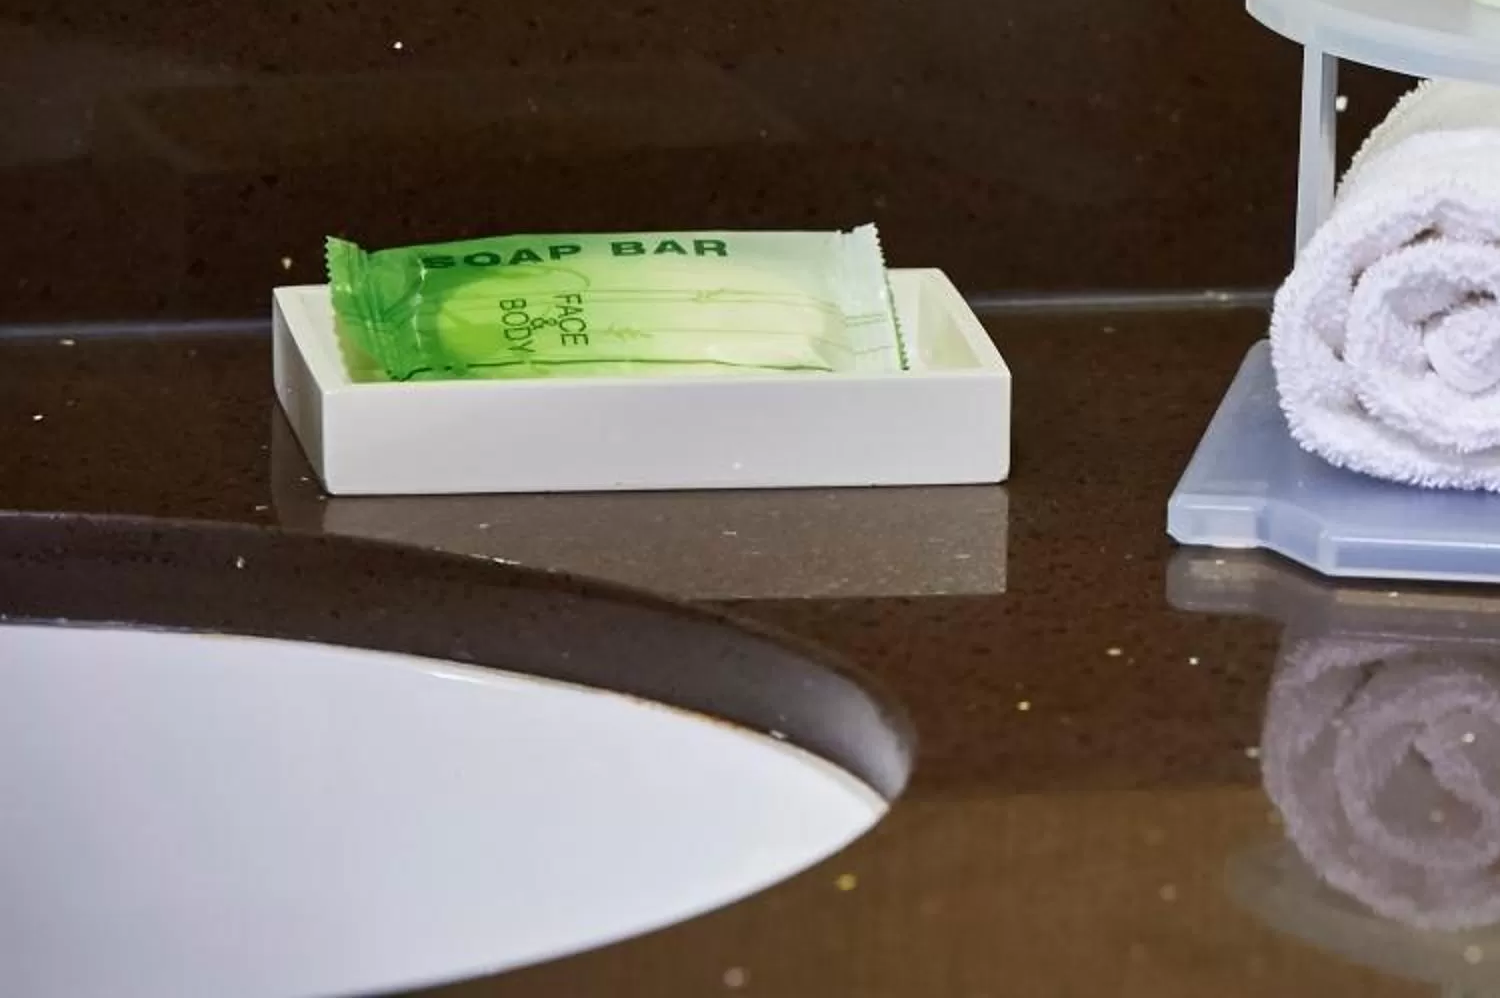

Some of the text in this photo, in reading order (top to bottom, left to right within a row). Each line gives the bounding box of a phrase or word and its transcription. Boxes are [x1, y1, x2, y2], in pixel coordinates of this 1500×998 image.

[421, 239, 728, 269] SOAP BAR
[499, 297, 536, 353] BODY
[530, 317, 557, 330] &
[553, 293, 589, 346] FACE
